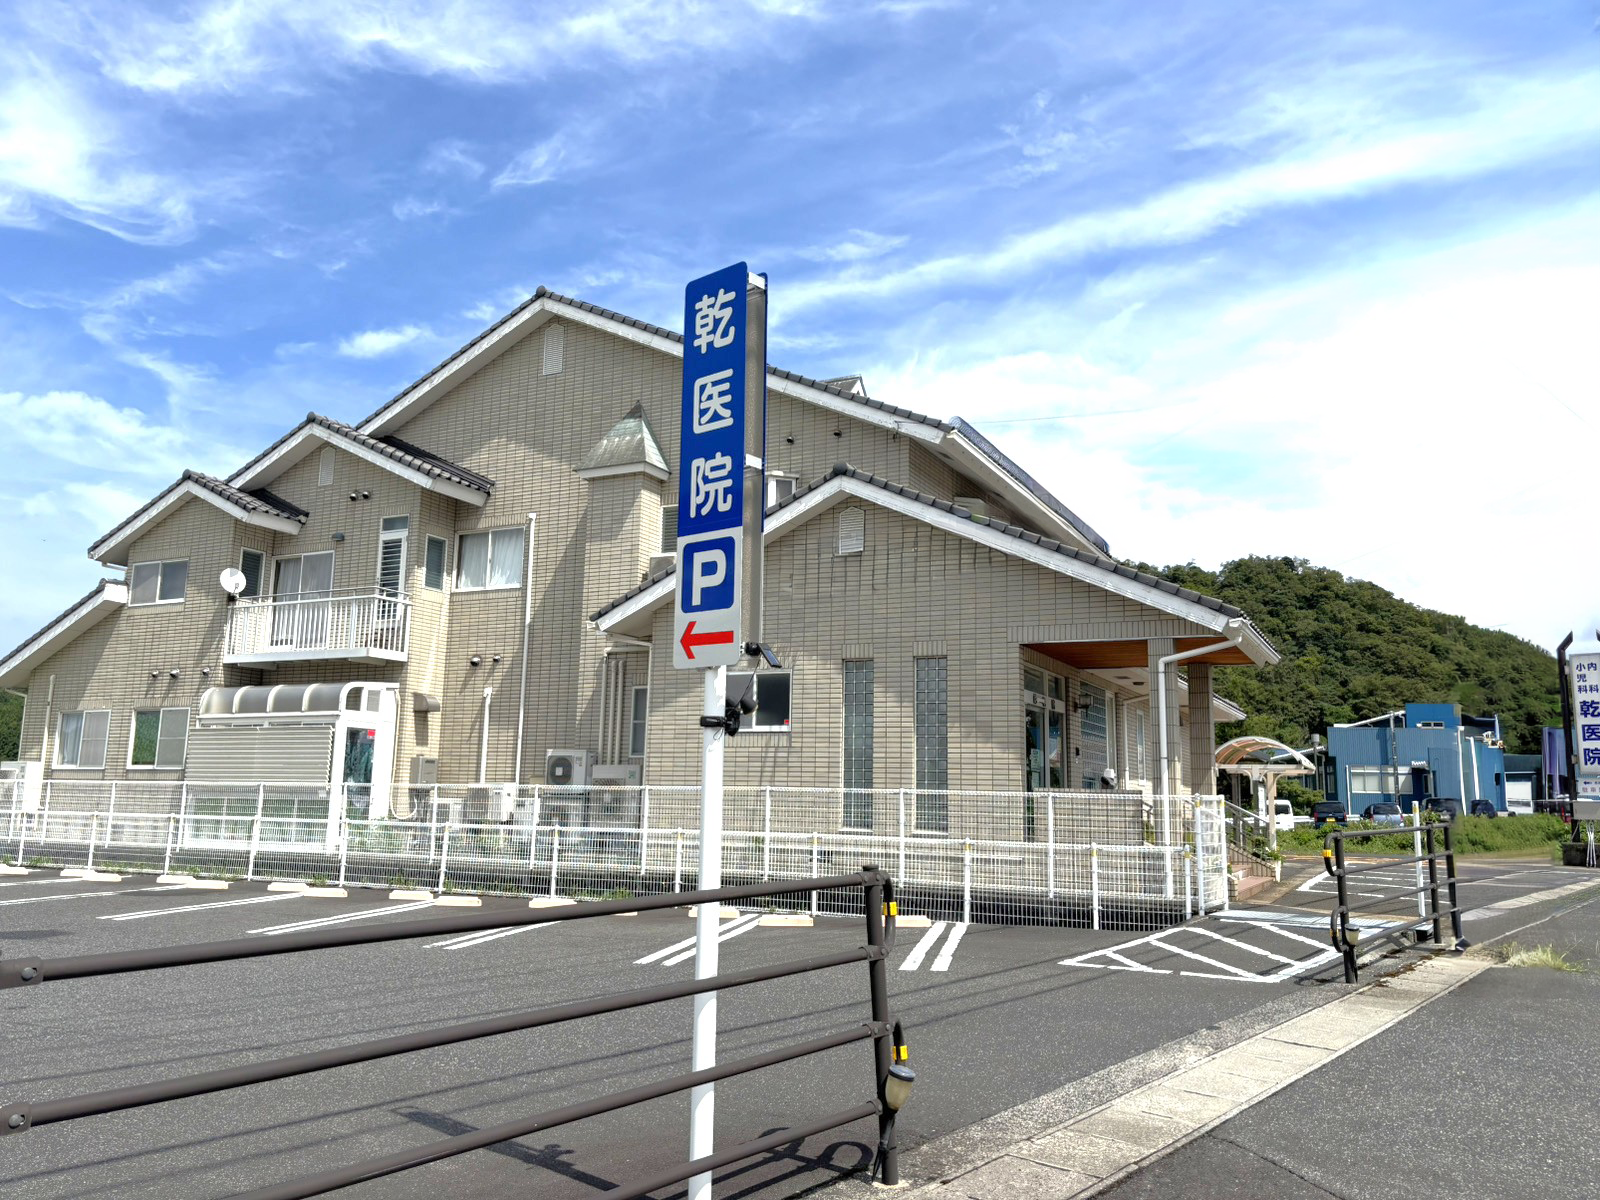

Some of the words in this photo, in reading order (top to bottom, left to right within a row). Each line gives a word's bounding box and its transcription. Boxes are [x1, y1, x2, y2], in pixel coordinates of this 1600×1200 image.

[690, 288, 736, 519] 乾医院
[691, 548, 727, 606] P
[1579, 700, 1600, 766] 乾医院
